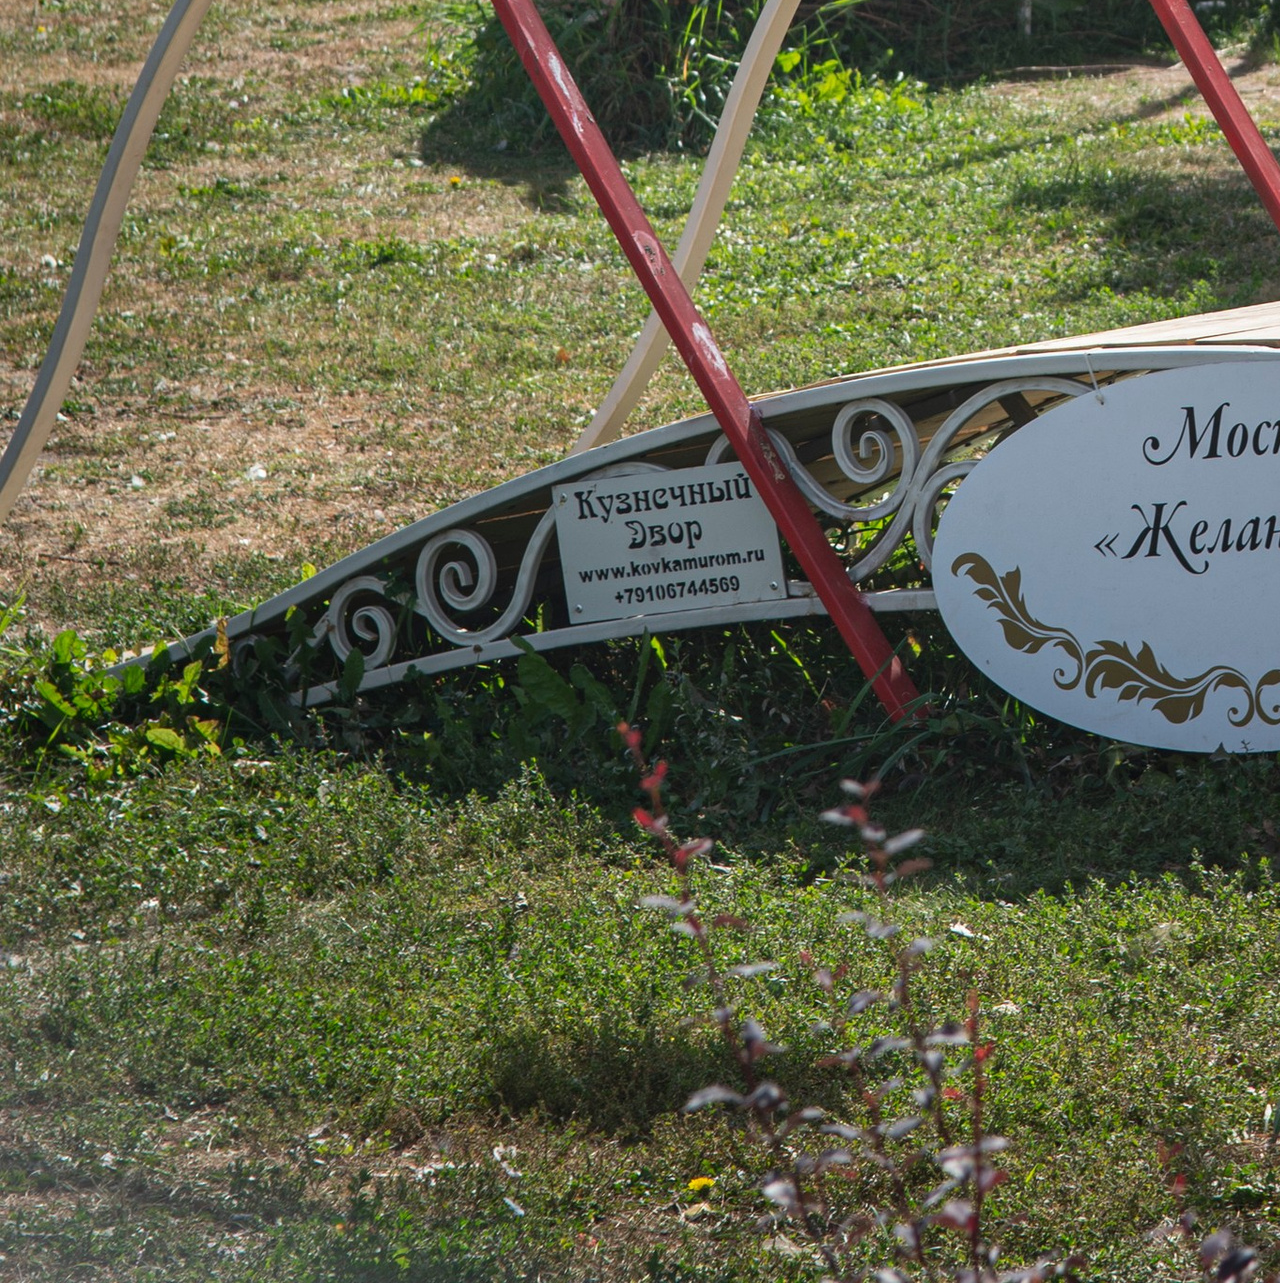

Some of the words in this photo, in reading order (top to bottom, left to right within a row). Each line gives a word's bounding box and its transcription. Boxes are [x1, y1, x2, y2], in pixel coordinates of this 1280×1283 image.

[574, 472, 753, 524] Кузнечный
[624, 519, 703, 550] Двор
[578, 548, 765, 584] www.kovkamurom.ru
[614, 575, 741, 605] +79106744569
